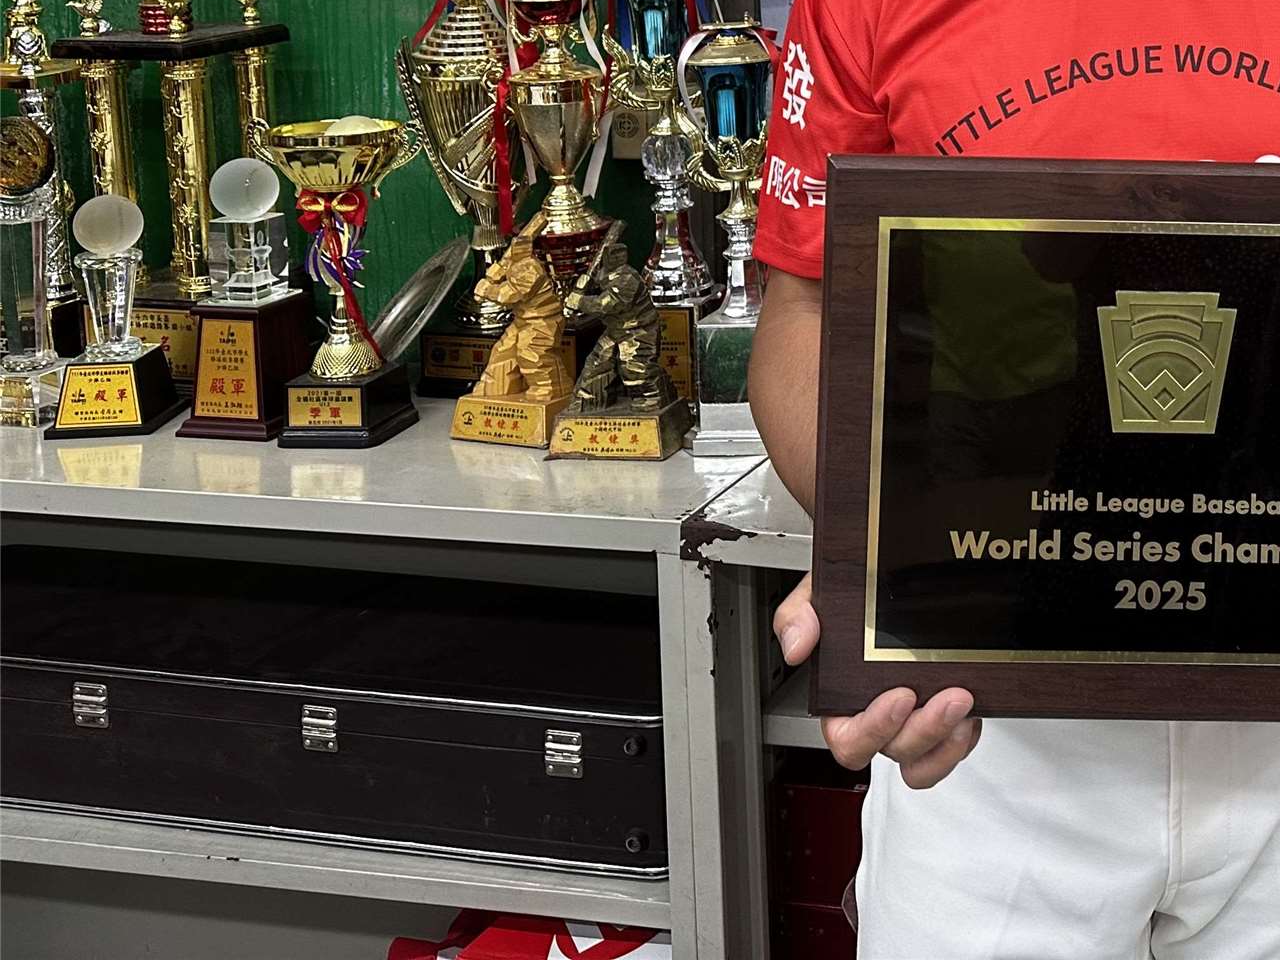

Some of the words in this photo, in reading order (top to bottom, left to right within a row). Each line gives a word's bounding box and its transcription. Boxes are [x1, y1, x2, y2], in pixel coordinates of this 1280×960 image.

[782, 40, 815, 130] 發
[935, 88, 1021, 156] ITTLE
[1024, 45, 1163, 104] LEAGUE
[209, 378, 247, 397] 殿軍
[1031, 490, 1089, 512] Little
[1096, 491, 1185, 519] League
[950, 528, 1061, 561] World
[1072, 531, 1181, 563] Series
[1114, 579, 1207, 611] 2025
